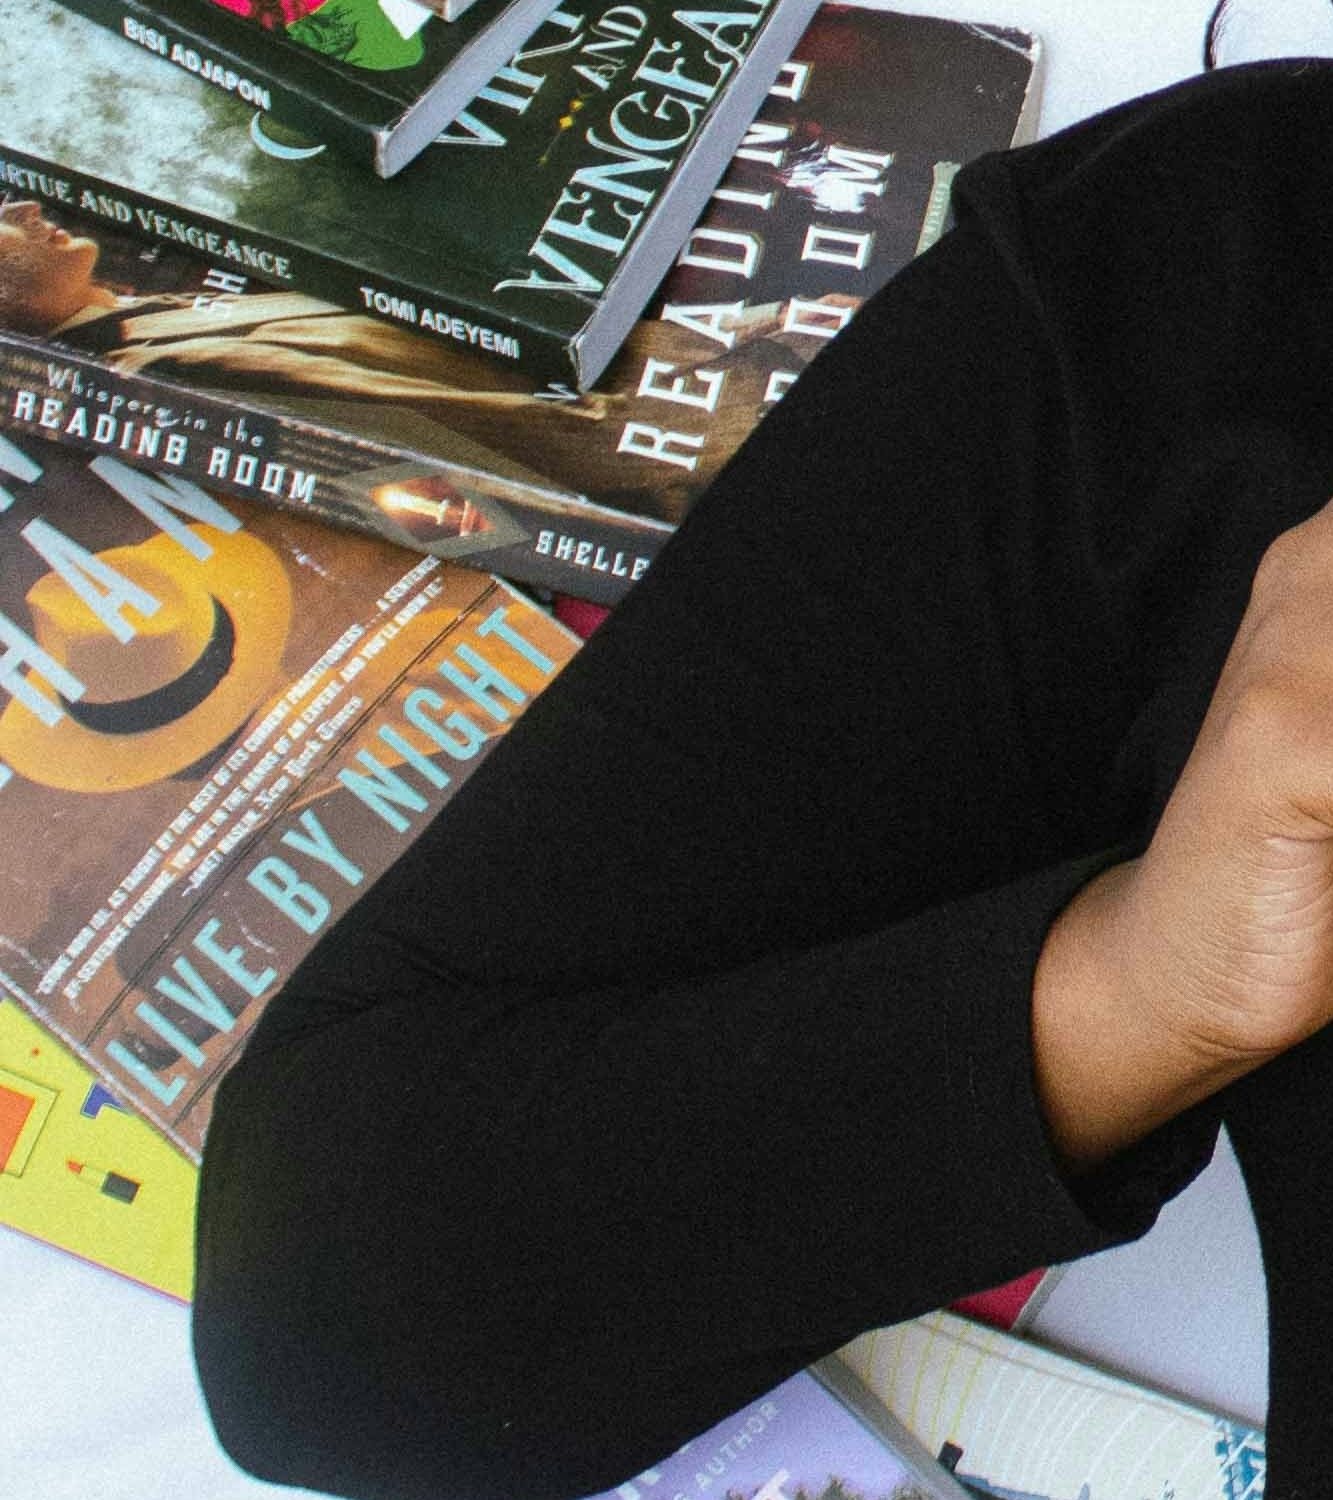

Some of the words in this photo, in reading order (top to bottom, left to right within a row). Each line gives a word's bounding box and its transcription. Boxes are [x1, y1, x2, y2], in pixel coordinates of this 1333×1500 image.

[122, 15, 169, 56] BISI
[169, 41, 273, 112] ADJAPON
[572, 3, 647, 92] AND
[79, 188, 134, 226] AND
[135, 207, 294, 282] VENGEANCE
[360, 286, 418, 326] TOMI
[418, 306, 521, 362] ADEYEMI
[13, 389, 190, 468] READING
[207, 444, 321, 507] ROOM
[222, 417, 266, 450] the
[104, 916, 278, 1108] LIVE
[246, 809, 365, 937] BY
[335, 606, 556, 834] NIGHT
[693, 1398, 781, 1491] AUTHOR
